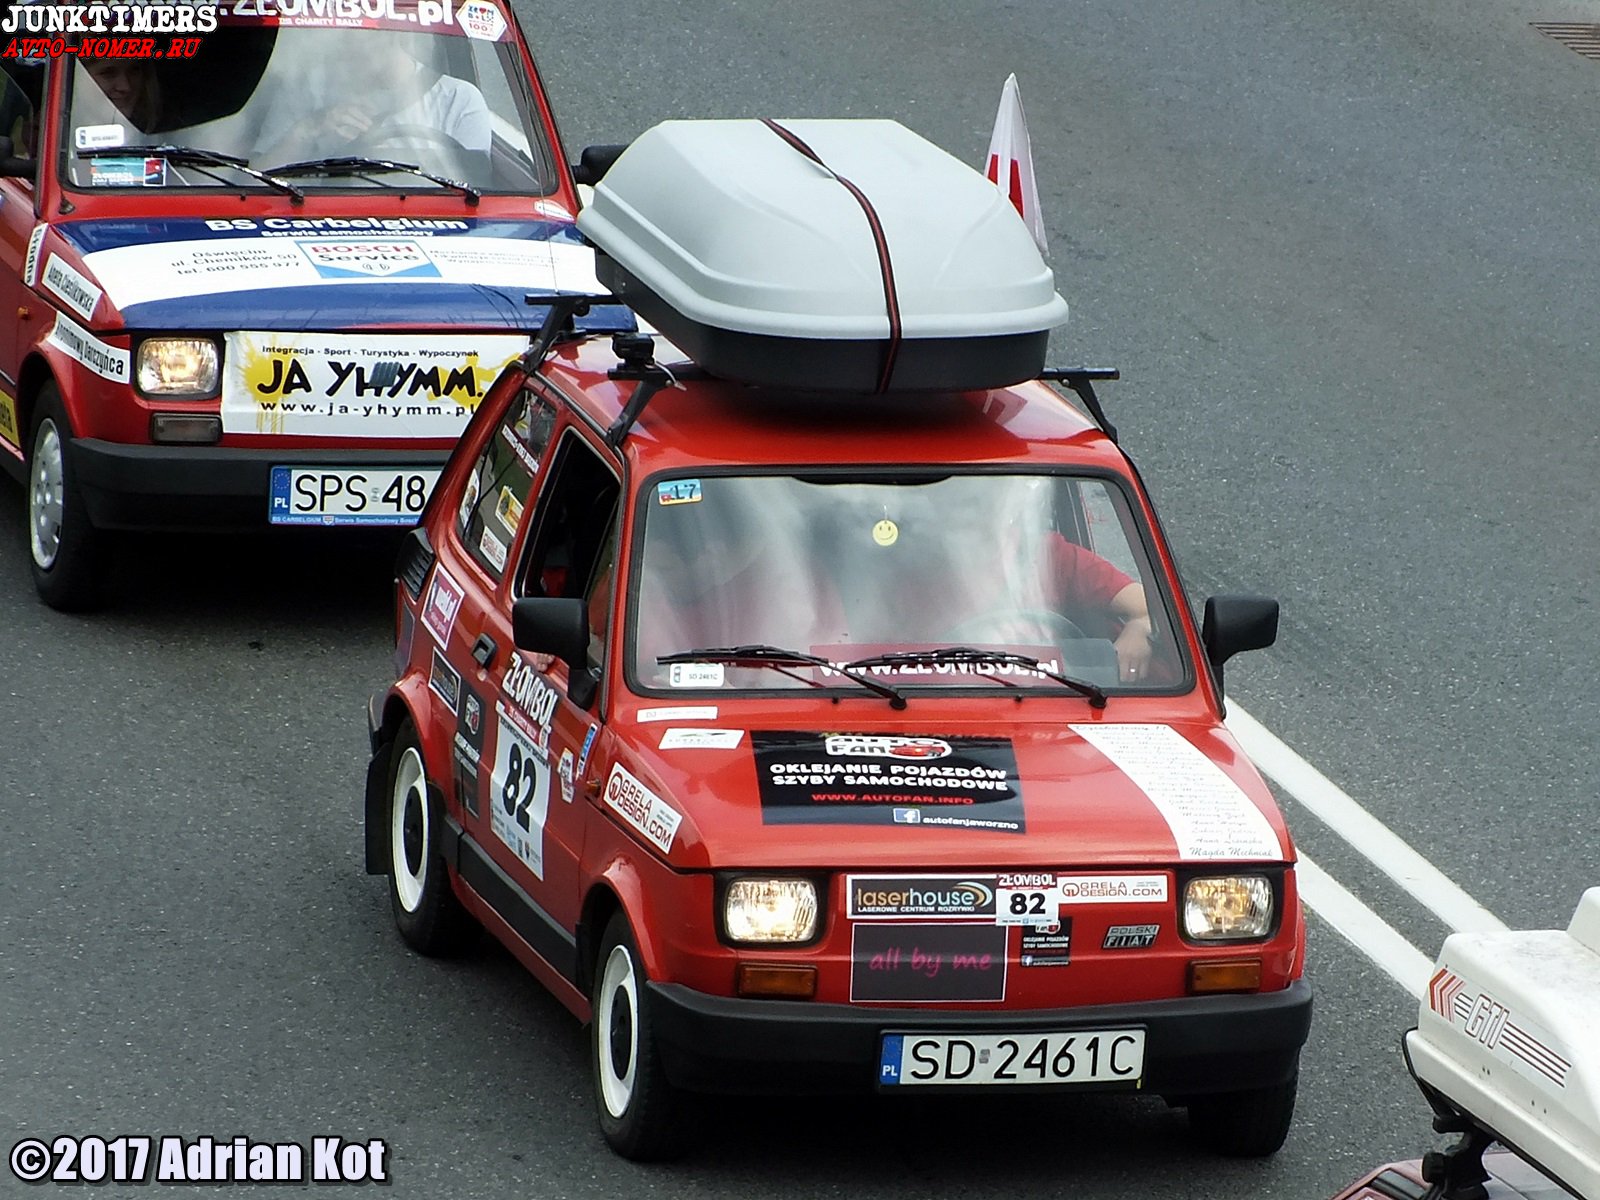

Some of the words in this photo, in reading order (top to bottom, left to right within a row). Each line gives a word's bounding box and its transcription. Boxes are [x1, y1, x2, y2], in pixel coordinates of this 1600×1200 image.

[205, 219, 258, 231] BS
[264, 217, 469, 230] Carbelgium
[320, 229, 434, 237] samochodowy
[311, 245, 414, 253] BOSCH
[318, 253, 419, 262] Service
[177, 267, 203, 276] tel.
[206, 264, 236, 273] 600
[261, 345, 315, 356] Integracja
[323, 347, 351, 357] Sport
[361, 349, 410, 358] Turystyka
[418, 349, 479, 359] Wypoczynek
[257, 358, 312, 396] JA
[260, 402, 475, 417] www.ja-yhymm.pl
[294, 474, 368, 512] SPS
[381, 475, 426, 512] 48
[274, 497, 289, 508] PL
[769, 763, 883, 775] OKLEJANIE
[889, 764, 1008, 780] POJAZDÓW
[502, 743, 537, 833] 82
[772, 774, 836, 786] SZYBY
[844, 775, 1009, 792] SAMOCHODOWE
[620, 778, 653, 815] GRELA
[616, 793, 672, 848] DESIGN.COM
[922, 815, 1019, 830] autofanjaworzno
[998, 874, 1056, 887] ZŁOMBOL
[857, 887, 975, 906] laserhouse
[1080, 888, 1163, 897] DESIGN.COM
[1009, 892, 1047, 915] 82
[1109, 925, 1158, 936] POLSKI
[1105, 934, 1154, 947] FIAT
[868, 946, 900, 971] all
[910, 946, 942, 978] by
[951, 955, 993, 971] me
[1464, 993, 1511, 1050] GTI
[910, 1039, 976, 1080] SD
[993, 1035, 1137, 1080] 2461C
[882, 1065, 898, 1077] PL
